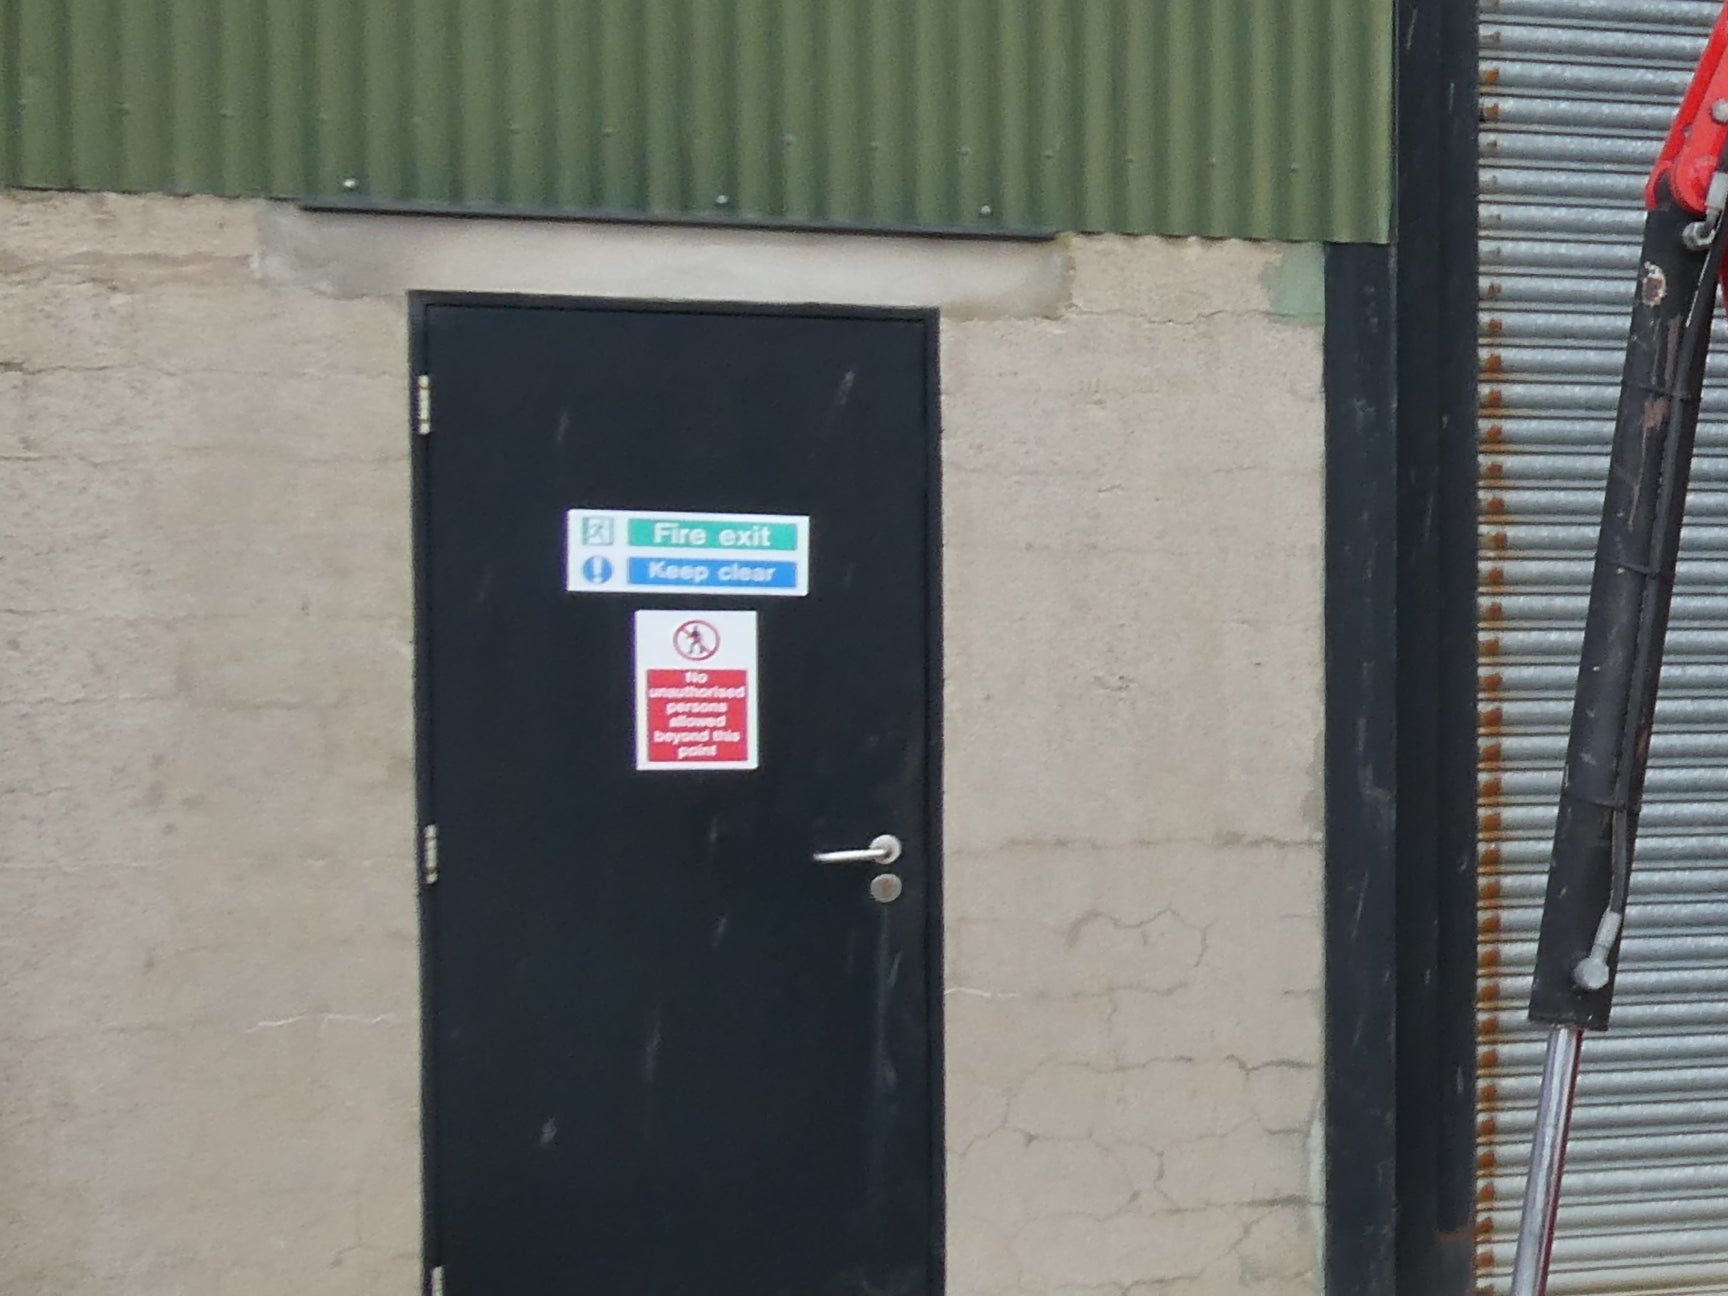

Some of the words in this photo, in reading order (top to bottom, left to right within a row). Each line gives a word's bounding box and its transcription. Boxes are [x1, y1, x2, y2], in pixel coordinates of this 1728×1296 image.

[653, 522, 707, 545] Fire
[718, 525, 771, 547] exit
[649, 560, 709, 583] Keep
[717, 562, 776, 582] clear
[685, 671, 708, 683] No
